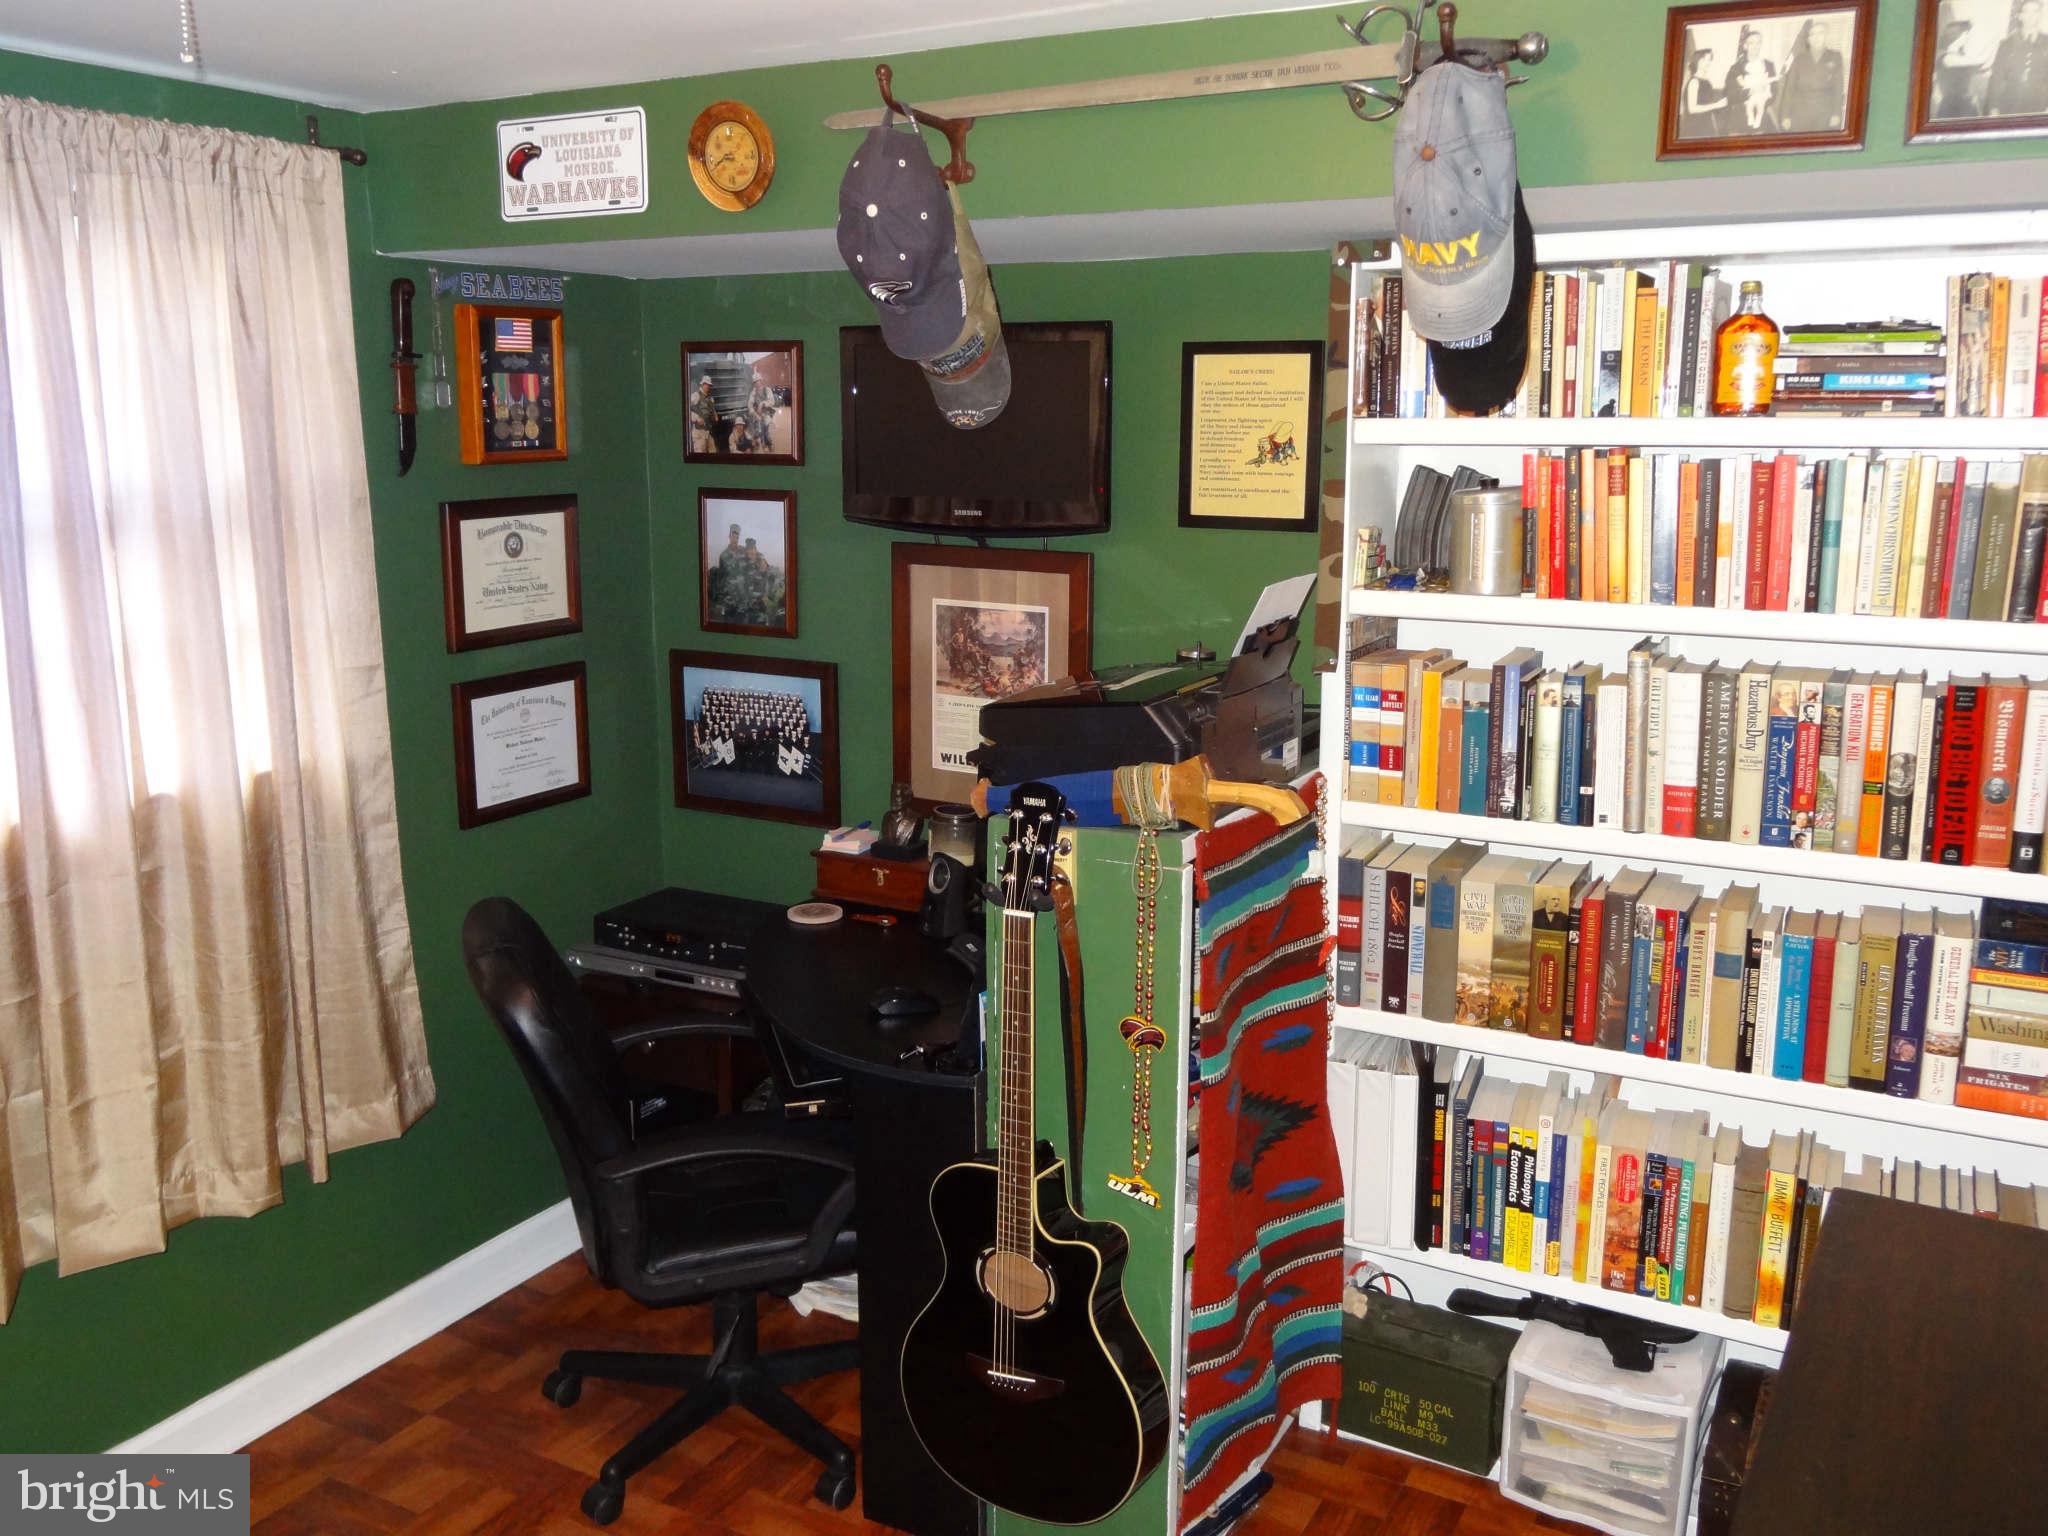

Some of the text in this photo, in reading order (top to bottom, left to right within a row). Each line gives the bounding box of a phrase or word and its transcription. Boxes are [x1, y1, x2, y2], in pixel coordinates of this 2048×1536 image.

[541, 127, 635, 148] UNIVERSITY OF
[555, 146, 622, 163] LOUISIANA
[564, 161, 614, 178] MONROE
[506, 176, 639, 207] WARHAWKS
[1400, 231, 1480, 266] NAVY
[460, 271, 565, 302] SEABEES
[1542, 287, 1553, 372] The Unfettered Mind
[1639, 317, 1651, 386] THE KORAN
[1839, 375, 1906, 385] KING LEAR
[1753, 499, 1765, 573] YOUNG JEFFERSON
[1354, 693, 1379, 702] THE ILIAD
[1382, 699, 1403, 709] ODYSSEY
[1388, 692, 1398, 700] THE
[1649, 677, 1663, 740] GRIFTOPIA
[1739, 679, 1768, 752] Hazardous Duty
[1846, 692, 1865, 763] GENERATION KILL
[1870, 689, 1888, 752] FREAKONOMICS
[1700, 681, 1714, 818] GENERAL TOMMY FRANKS
[1713, 681, 1731, 819] AMERICAN SOLDIER
[1992, 699, 2015, 772] Bismarck
[2033, 713, 2048, 776] Intellectuals
[941, 752, 977, 768] WIL
[1765, 736, 1780, 818] WALTER ISAACSON
[1775, 731, 1794, 820] Benjamin Franklin
[1796, 730, 1808, 789] MICHAEL BESCHLOSS
[1804, 725, 1817, 794] PRESIDENTIAL COURAGE
[1023, 797, 1047, 808] YAMAHA
[2026, 791, 2040, 826] Society
[1889, 806, 1898, 835] EVERITT
[1898, 805, 1907, 838] ANTHONY
[1464, 892, 1488, 903] CIVIL
[1466, 901, 1486, 911] WAR
[1501, 895, 1526, 905] CIVIL
[1504, 904, 1523, 913] WAR
[1586, 909, 1596, 944] ROBERT
[1609, 913, 1619, 951] AMERICAN
[1622, 899, 1633, 940] JEFFERSON
[1367, 937, 1377, 965] 1862
[1410, 923, 1425, 976] STONEWALL
[1584, 957, 1594, 975] LEE
[1689, 929, 1706, 999] MOSBY'S RANGERS
[1749, 968, 1759, 988] LINCOLN
[1760, 989, 1769, 1002] LEE
[1878, 964, 1892, 993] LEE'S
[1900, 939, 1919, 1032] Douglas Southall Freeman
[1944, 946, 1962, 1027] GENERAL LEE'S ARMY
[1747, 996, 1757, 1024] LEADERSHIP
[1783, 996, 1792, 1041] APPOMATTOX
[1792, 1000, 1800, 1034] STILLNESS
[1755, 1016, 1767, 1060] LEADERSHIP
[1872, 996, 1889, 1064] LIEUTENANTS
[1967, 1076, 2030, 1092] FRIGATES
[1987, 1072, 2010, 1081] SIX
[1434, 1109, 1445, 1141] SPANISH
[1107, 1178, 1157, 1208] ULM
[1508, 1149, 1521, 1204] Economics
[1521, 1154, 1534, 1208] Philosophy
[1597, 1157, 1607, 1209] FIRST PEOPLES
[1675, 1178, 1691, 1271] GETTING PUBLISHED
[1768, 1177, 1789, 1254] JIMMY BUFFETT
[1506, 1215, 1517, 1256] DUMMIES
[1519, 1220, 1530, 1261] DUMMIES
[1660, 1223, 1668, 1253] DEMOCRACY
[1665, 1227, 1674, 1263] PERFORMANCE
[1358, 1380, 1376, 1394] 100
[1418, 1399, 1432, 1410] 50
[1434, 1403, 1454, 1418] CAL
[1383, 1398, 1434, 1421] LINK M9
[1380, 1407, 1439, 1432] BALL M33
